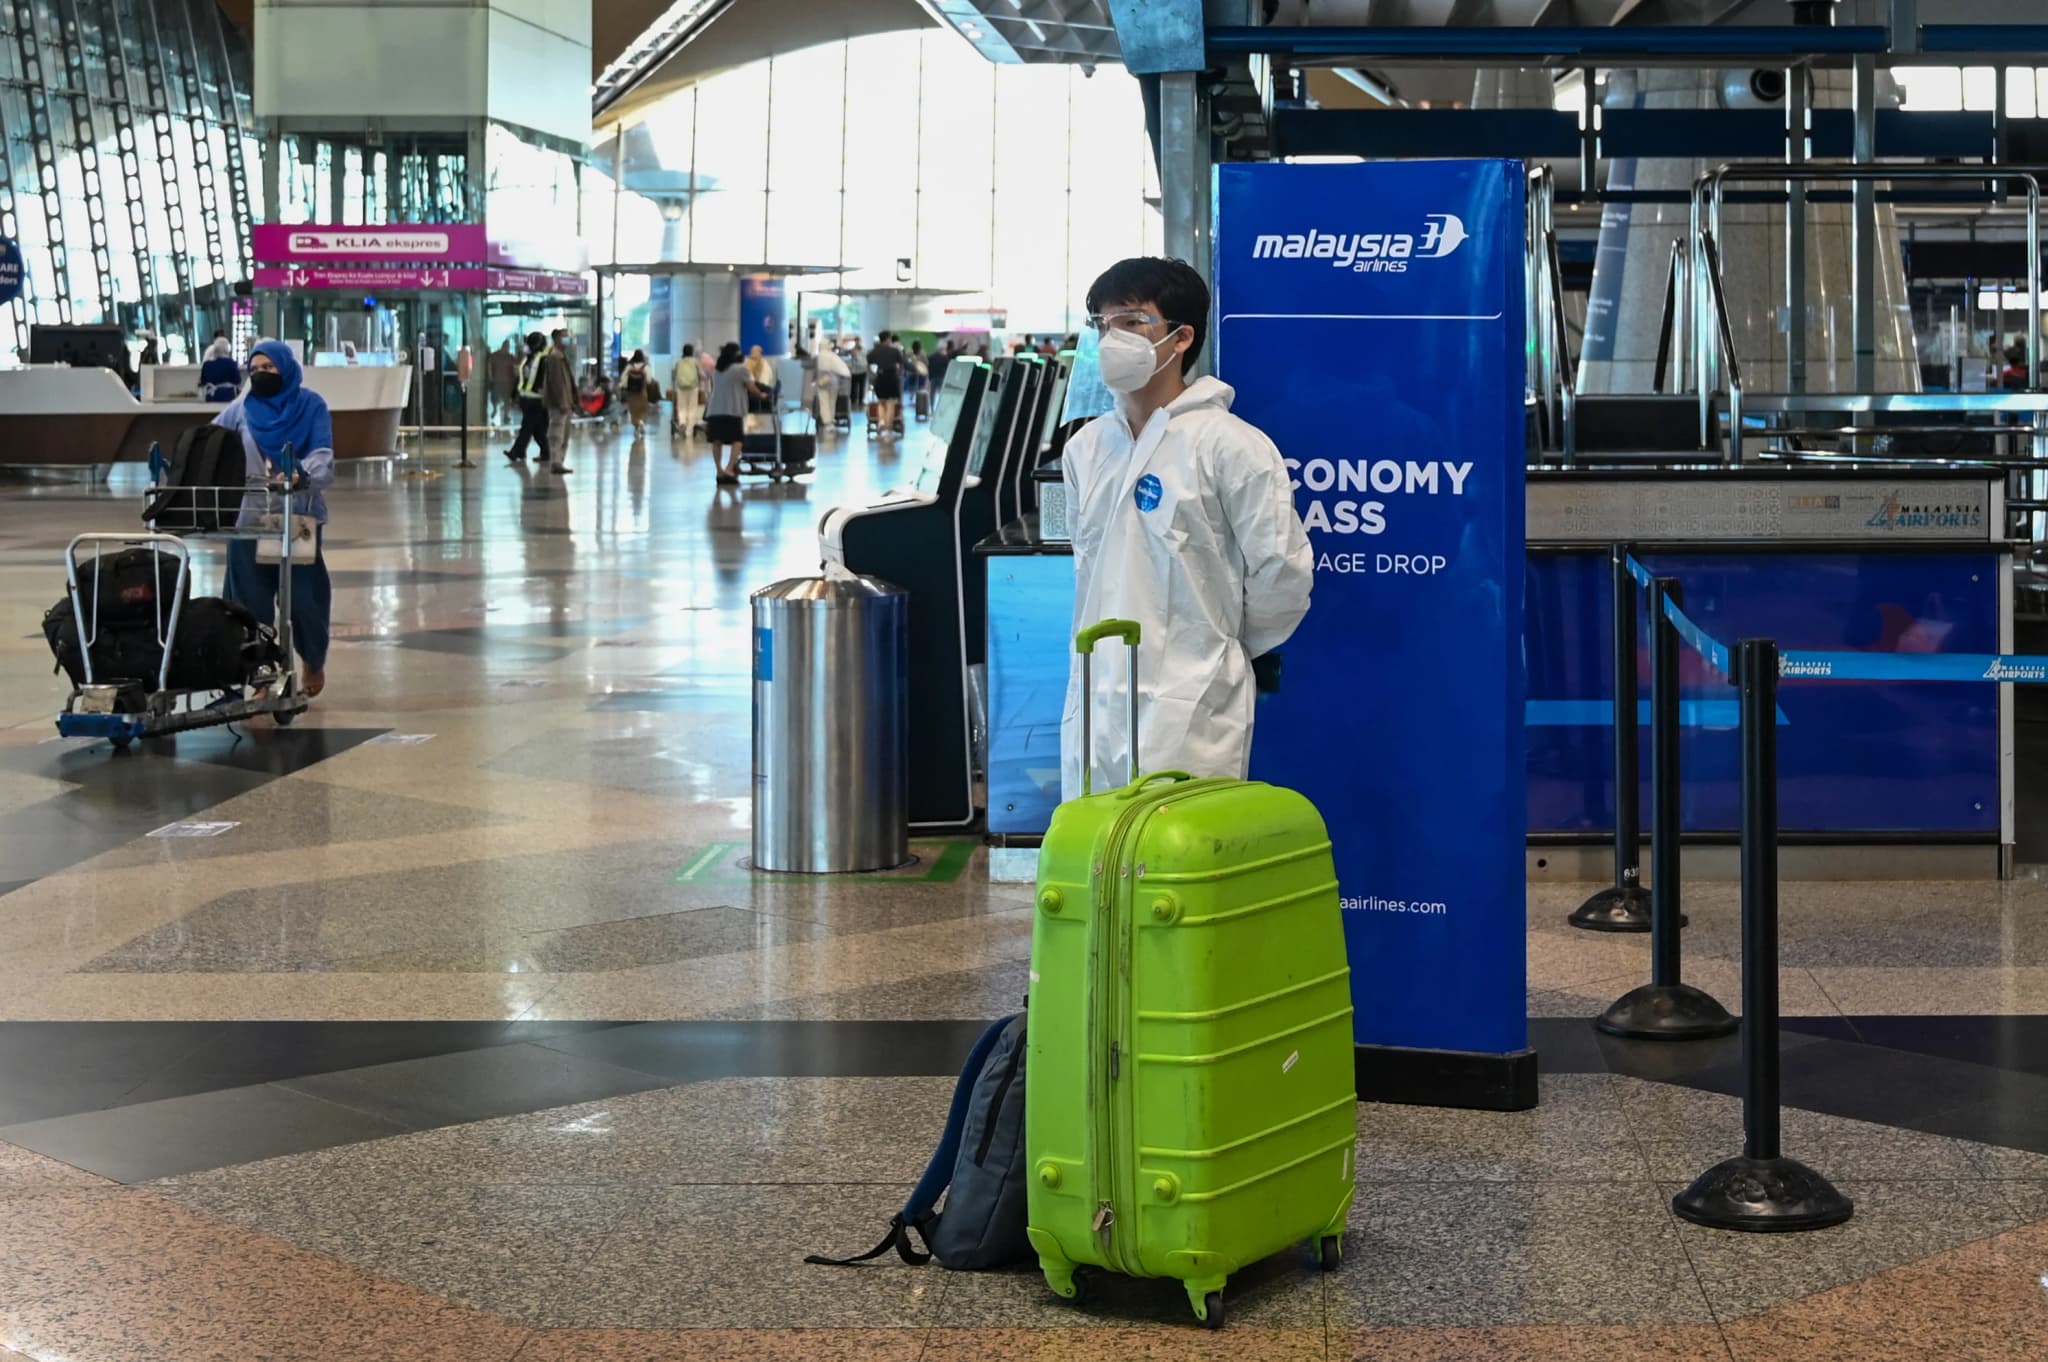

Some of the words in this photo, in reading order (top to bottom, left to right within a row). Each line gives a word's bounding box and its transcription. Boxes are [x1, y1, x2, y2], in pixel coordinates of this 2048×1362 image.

[336, 238, 381, 248] KLIA
[385, 239, 441, 251] ekspres
[1252, 229, 1413, 267] malaysia
[0, 263, 18, 272] ARE
[1353, 260, 1408, 273] airlines
[0, 274, 18, 285] dors
[1284, 458, 1474, 495] CONOMY
[1901, 505, 1980, 513] MALAYSIA
[1304, 500, 1386, 535] ASS
[1895, 512, 1981, 527] AIRPORTS
[1312, 553, 1366, 574] AGE
[1376, 554, 1446, 575] DROP
[1784, 666, 1832, 675] AIRPORTS
[1999, 670, 2045, 679] AIRPORTS
[1339, 895, 1447, 915] aairlines.com
